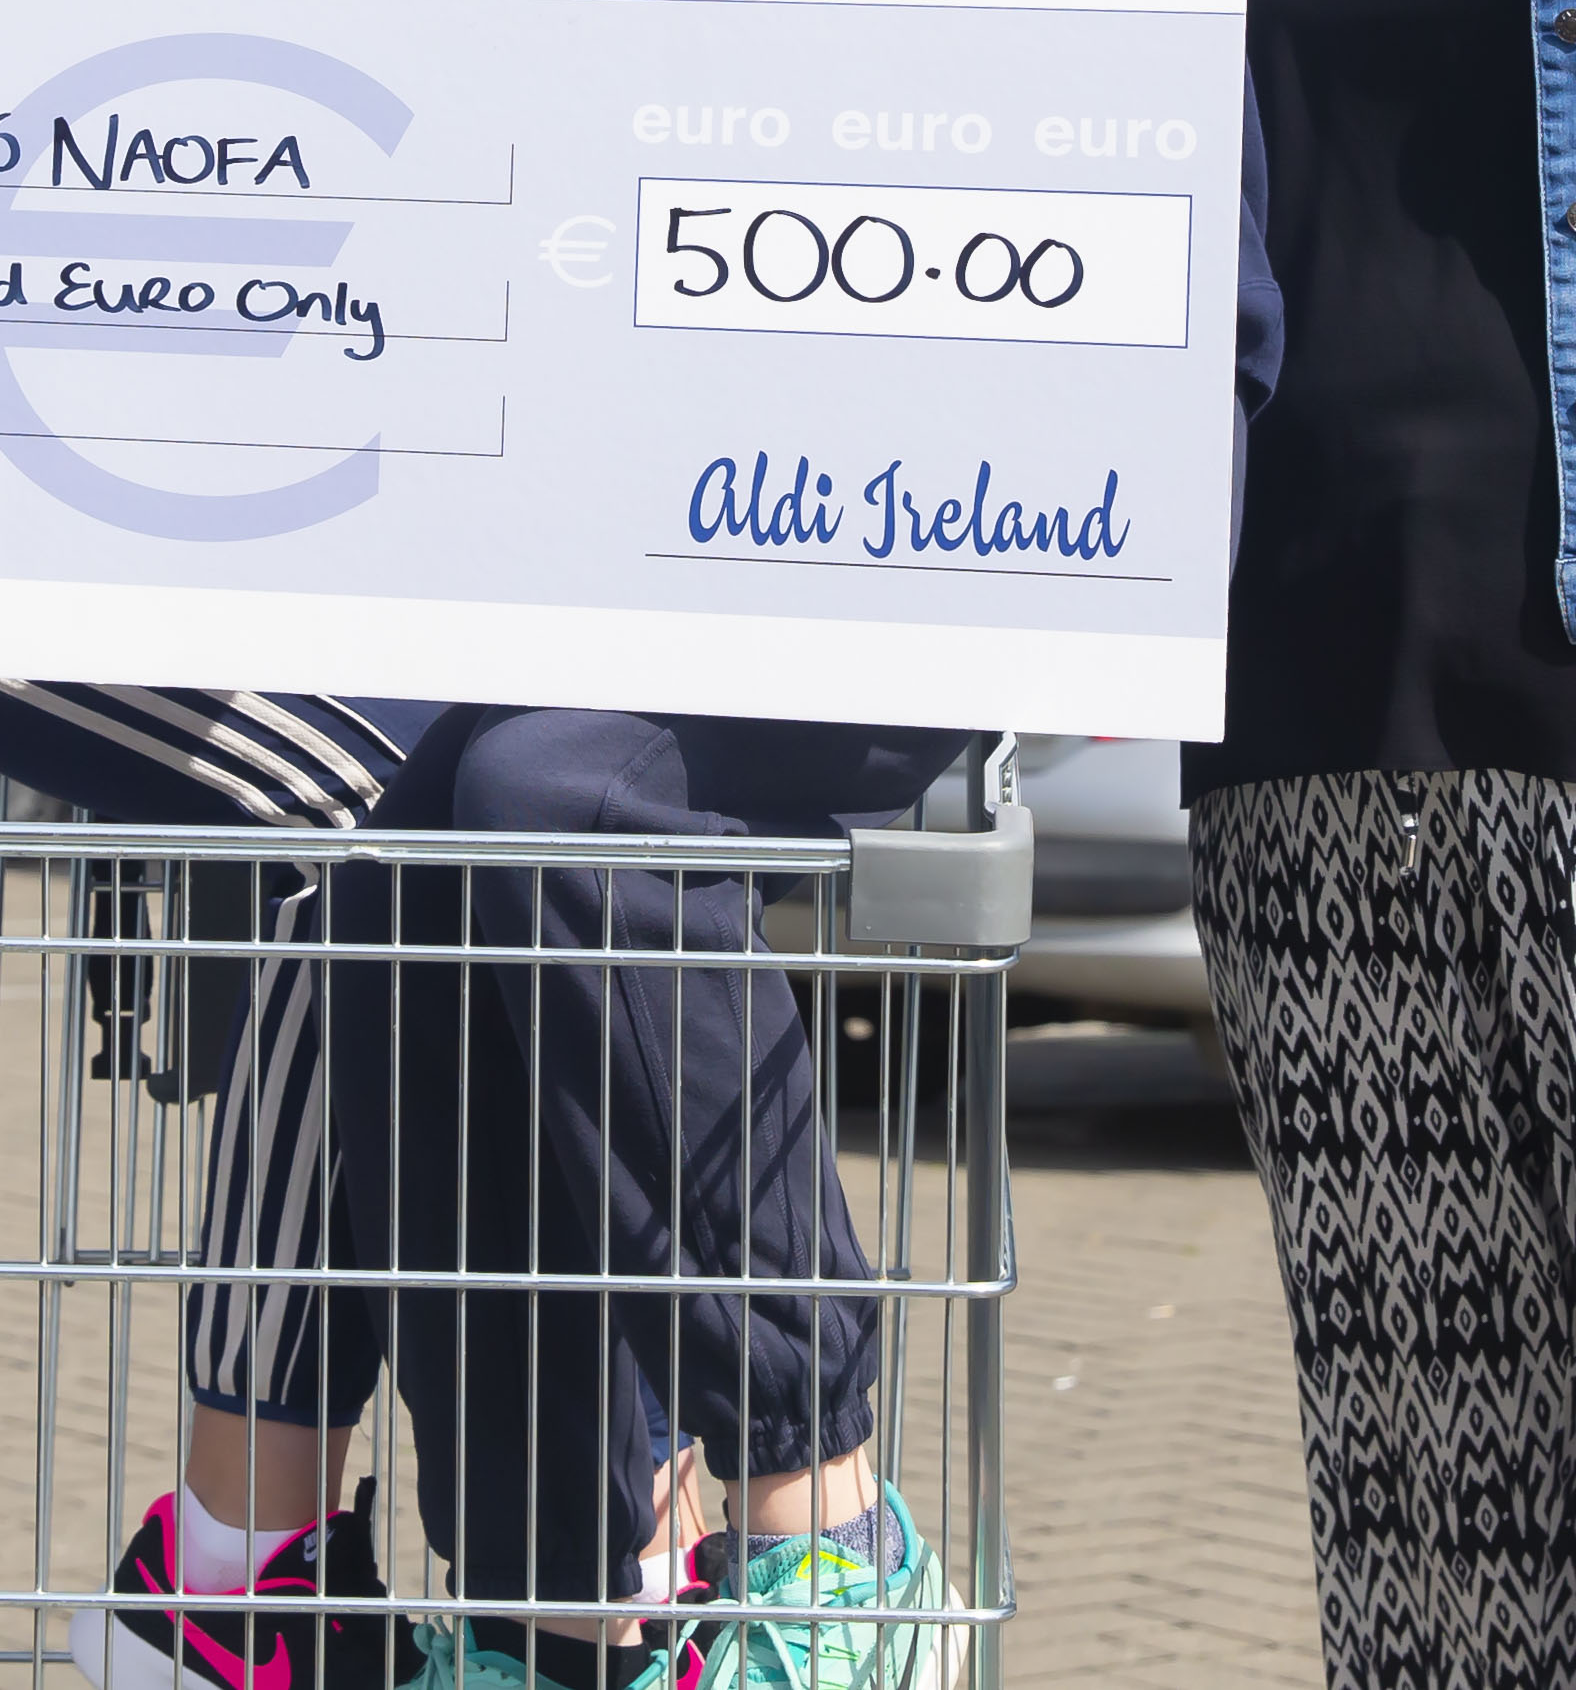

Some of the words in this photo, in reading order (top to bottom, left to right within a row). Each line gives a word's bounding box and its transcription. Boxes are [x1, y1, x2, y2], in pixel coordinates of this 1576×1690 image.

[52, 113, 311, 191] NAOFA
[632, 102, 791, 148] euro
[831, 108, 993, 154] euro
[1034, 114, 1197, 160] euro
[235, 279, 386, 361] Only
[688, 450, 844, 547] Aldi
[862, 459, 1131, 561] Ireland
